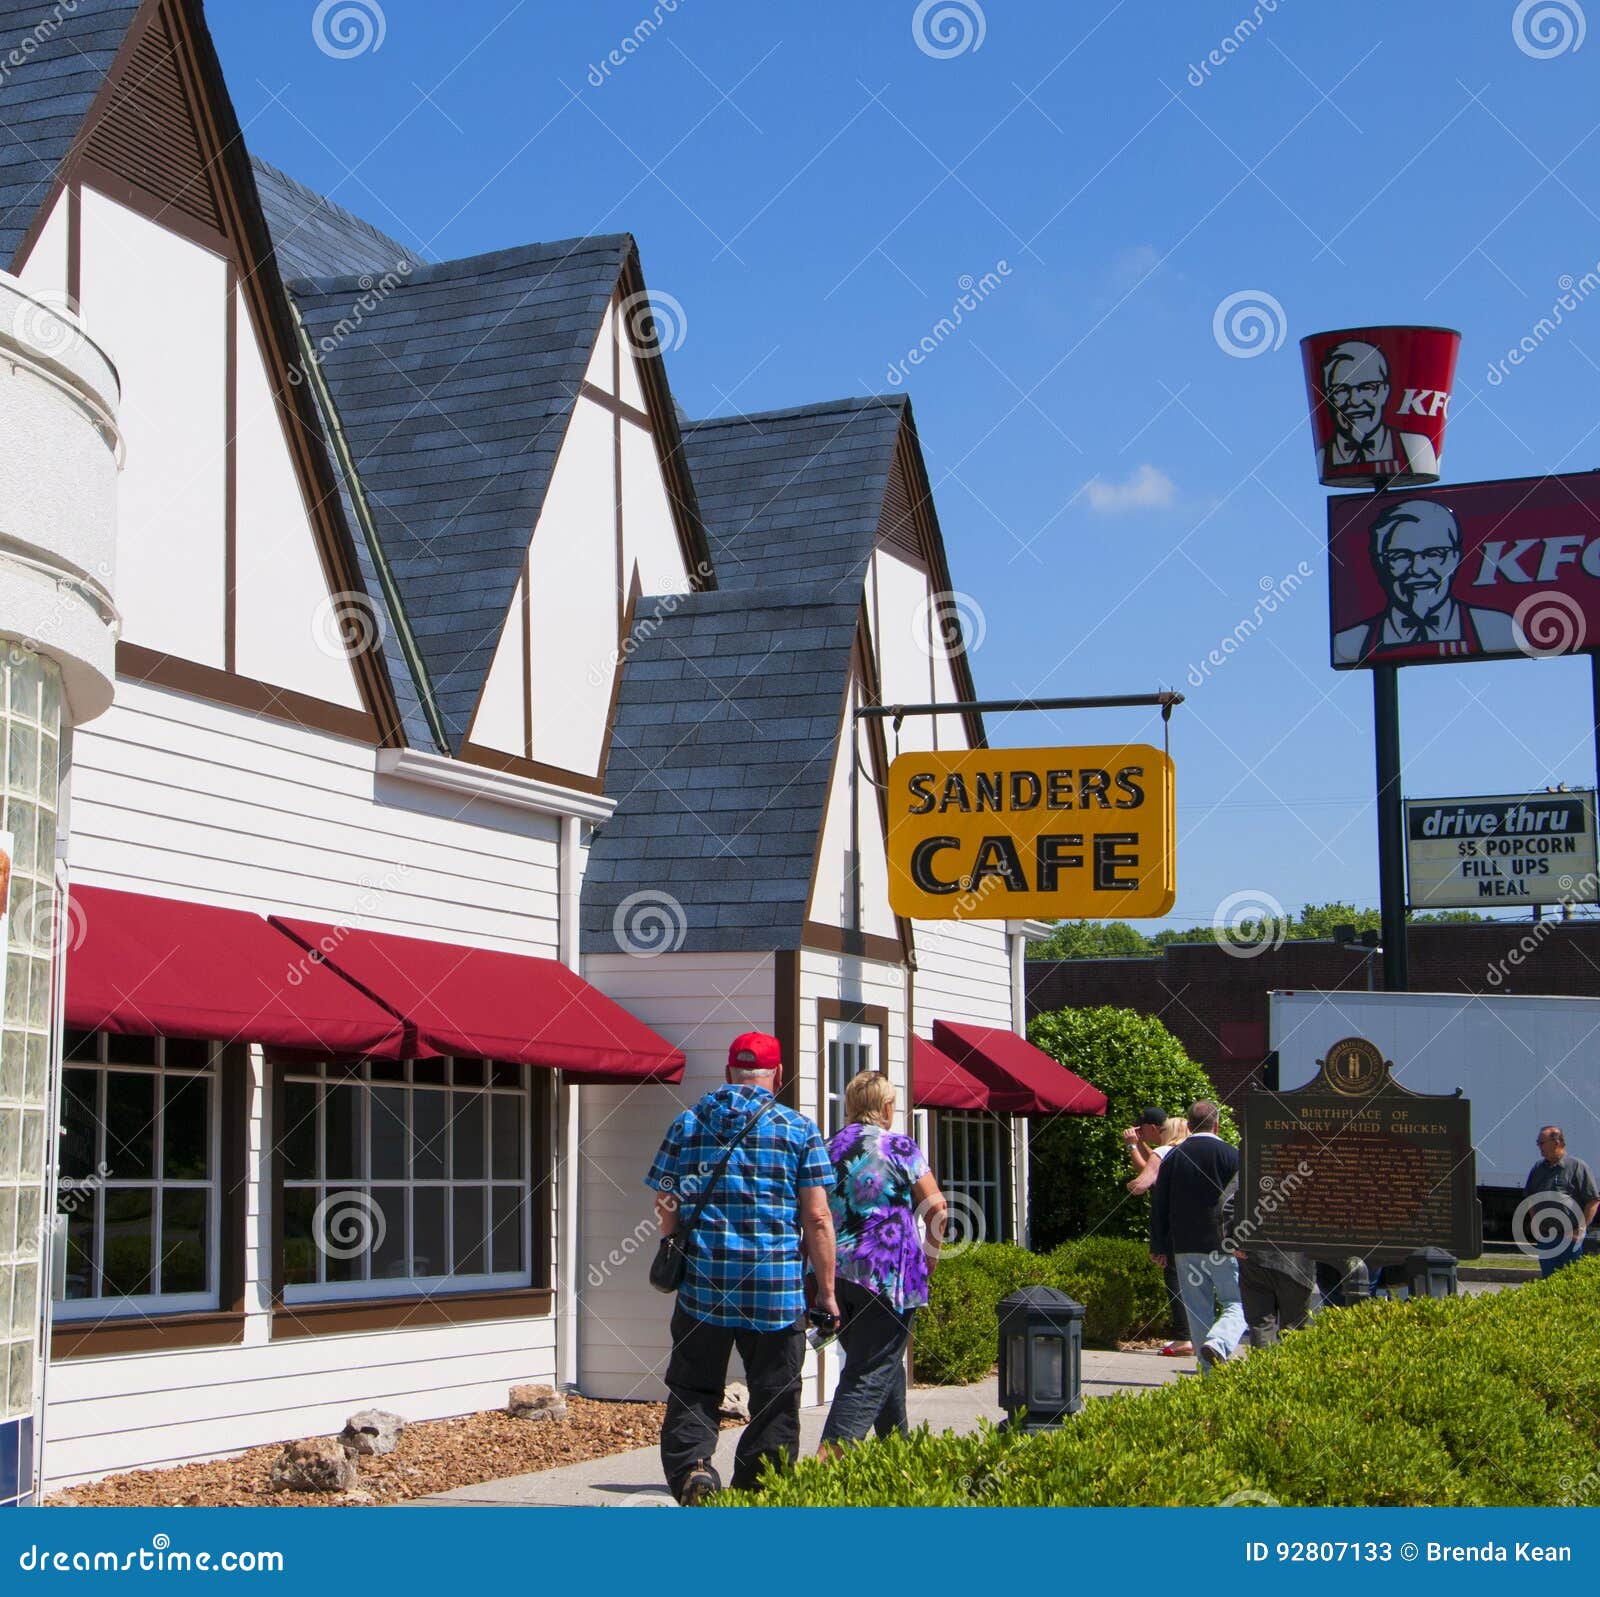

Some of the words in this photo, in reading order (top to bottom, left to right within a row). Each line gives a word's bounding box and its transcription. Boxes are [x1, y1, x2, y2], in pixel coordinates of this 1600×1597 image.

[908, 766, 1145, 815] SANDERS
[1422, 808, 1499, 836] drive
[1505, 805, 1569, 832] thru
[1458, 841, 1477, 857] $5
[1486, 837, 1576, 855] POPCORN
[910, 832, 1140, 895] CAFE
[1462, 860, 1502, 877] FILL
[1512, 858, 1550, 875] UPS
[1478, 879, 1530, 896] MEAL
[1301, 1107, 1382, 1120] BIRTHPLACE
[1392, 1110, 1409, 1121] OF
[1264, 1119, 1330, 1131] KENTUCKY
[1342, 1121, 1381, 1133] FRIED
[1390, 1123, 1447, 1135] CHICKEN
